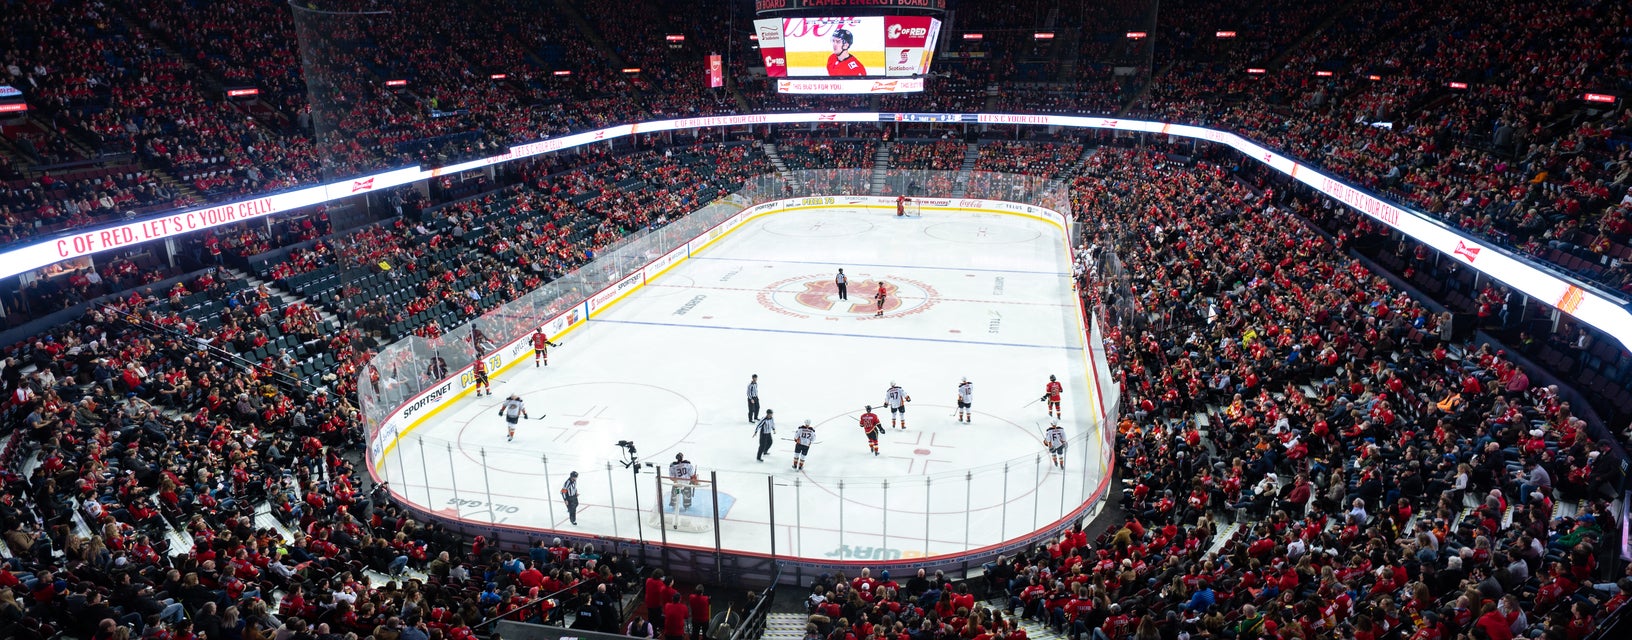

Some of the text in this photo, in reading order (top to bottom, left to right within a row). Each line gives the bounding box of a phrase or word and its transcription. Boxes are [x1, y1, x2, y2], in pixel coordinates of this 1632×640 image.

[909, 28, 926, 36] RED
[755, 202, 778, 211] SPORTSNET
[1344, 188, 1359, 206] LET'S
[1365, 198, 1380, 216] YOUR
[57, 198, 275, 257] C OF RED, LET'S C YOUR CELLY.
[489, 354, 501, 371] 73
[403, 382, 452, 419] SPORTSNET
[676, 467, 687, 477] 30
[447, 498, 482, 507] GAS
[495, 504, 519, 513] OIL
